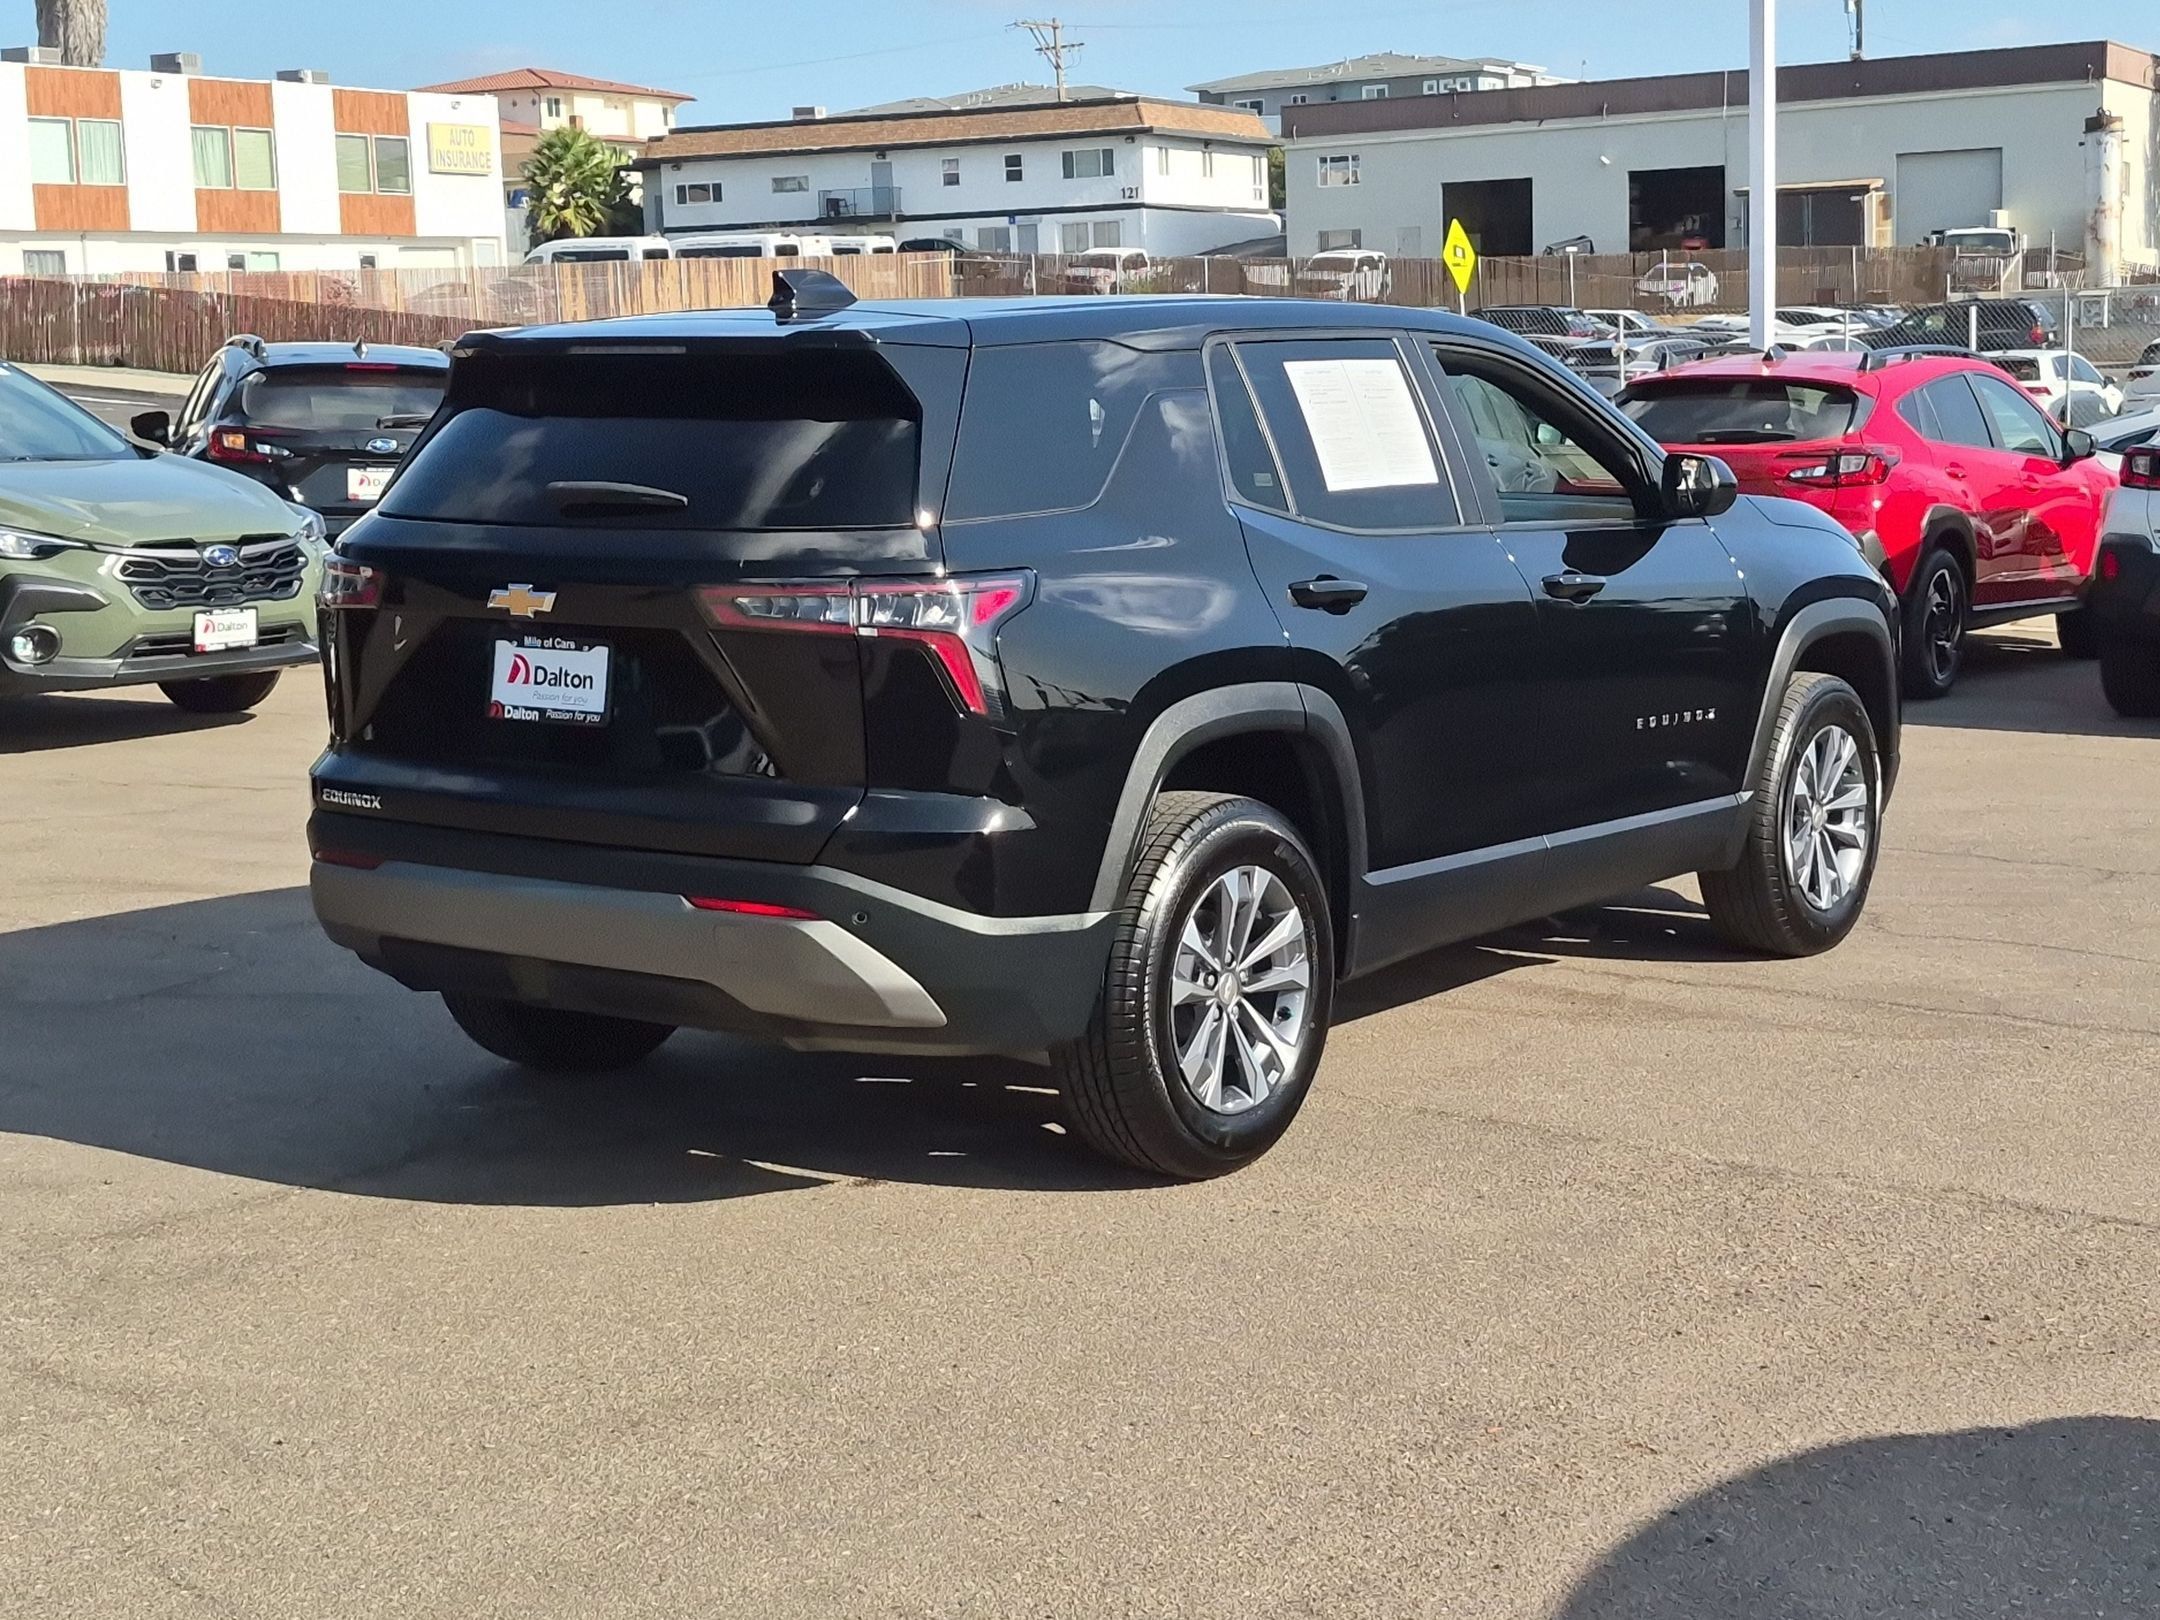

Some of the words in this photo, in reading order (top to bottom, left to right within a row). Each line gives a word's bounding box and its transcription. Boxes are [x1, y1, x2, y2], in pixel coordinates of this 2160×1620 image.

[449, 128, 475, 147] AUTO
[435, 149, 492, 169] INSURANCE
[1121, 186, 1139, 200] 121
[217, 621, 253, 632] Dalton
[554, 638, 576, 649] Cars
[534, 665, 593, 690] Dalton
[532, 690, 560, 701] Passion
[561, 693, 573, 704] for
[573, 695, 589, 704] you
[504, 705, 540, 721] Dalton
[545, 708, 573, 720] Passion
[573, 711, 586, 721] for
[585, 713, 601, 723] you
[322, 786, 382, 810] EQUINOX
